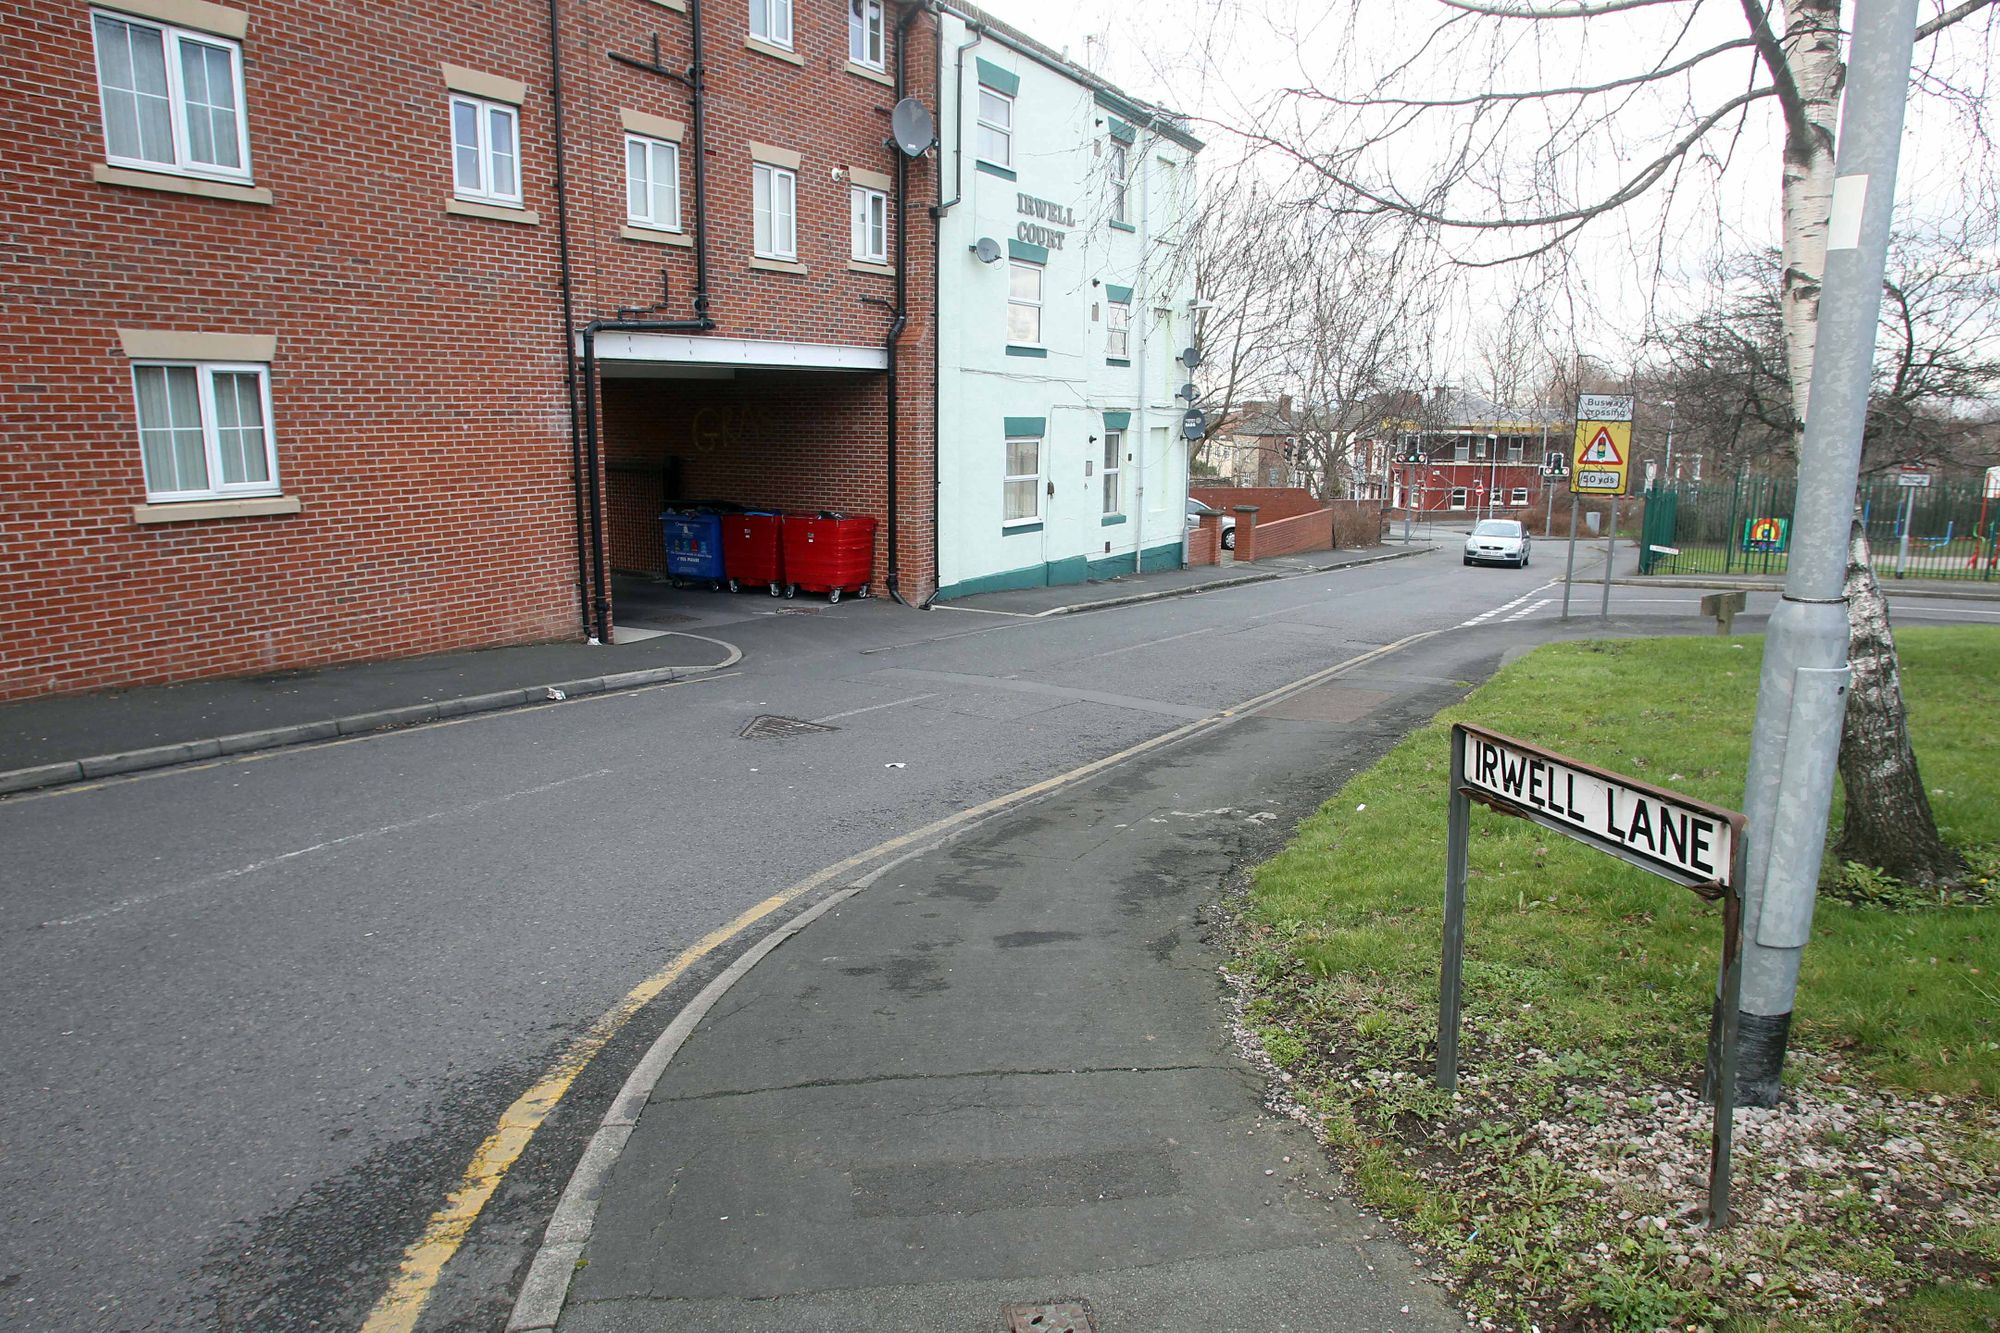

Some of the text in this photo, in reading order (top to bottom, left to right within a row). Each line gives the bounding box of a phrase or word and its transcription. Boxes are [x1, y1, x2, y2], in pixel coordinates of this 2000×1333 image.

[1016, 192, 1075, 227] IRWELL
[1017, 221, 1065, 250] COURT
[1587, 398, 1625, 408] Busway
[1585, 408, 1625, 418] crossing
[1583, 475, 1615, 484] 50 yds
[1475, 740, 1713, 875] IRWELL LANE
